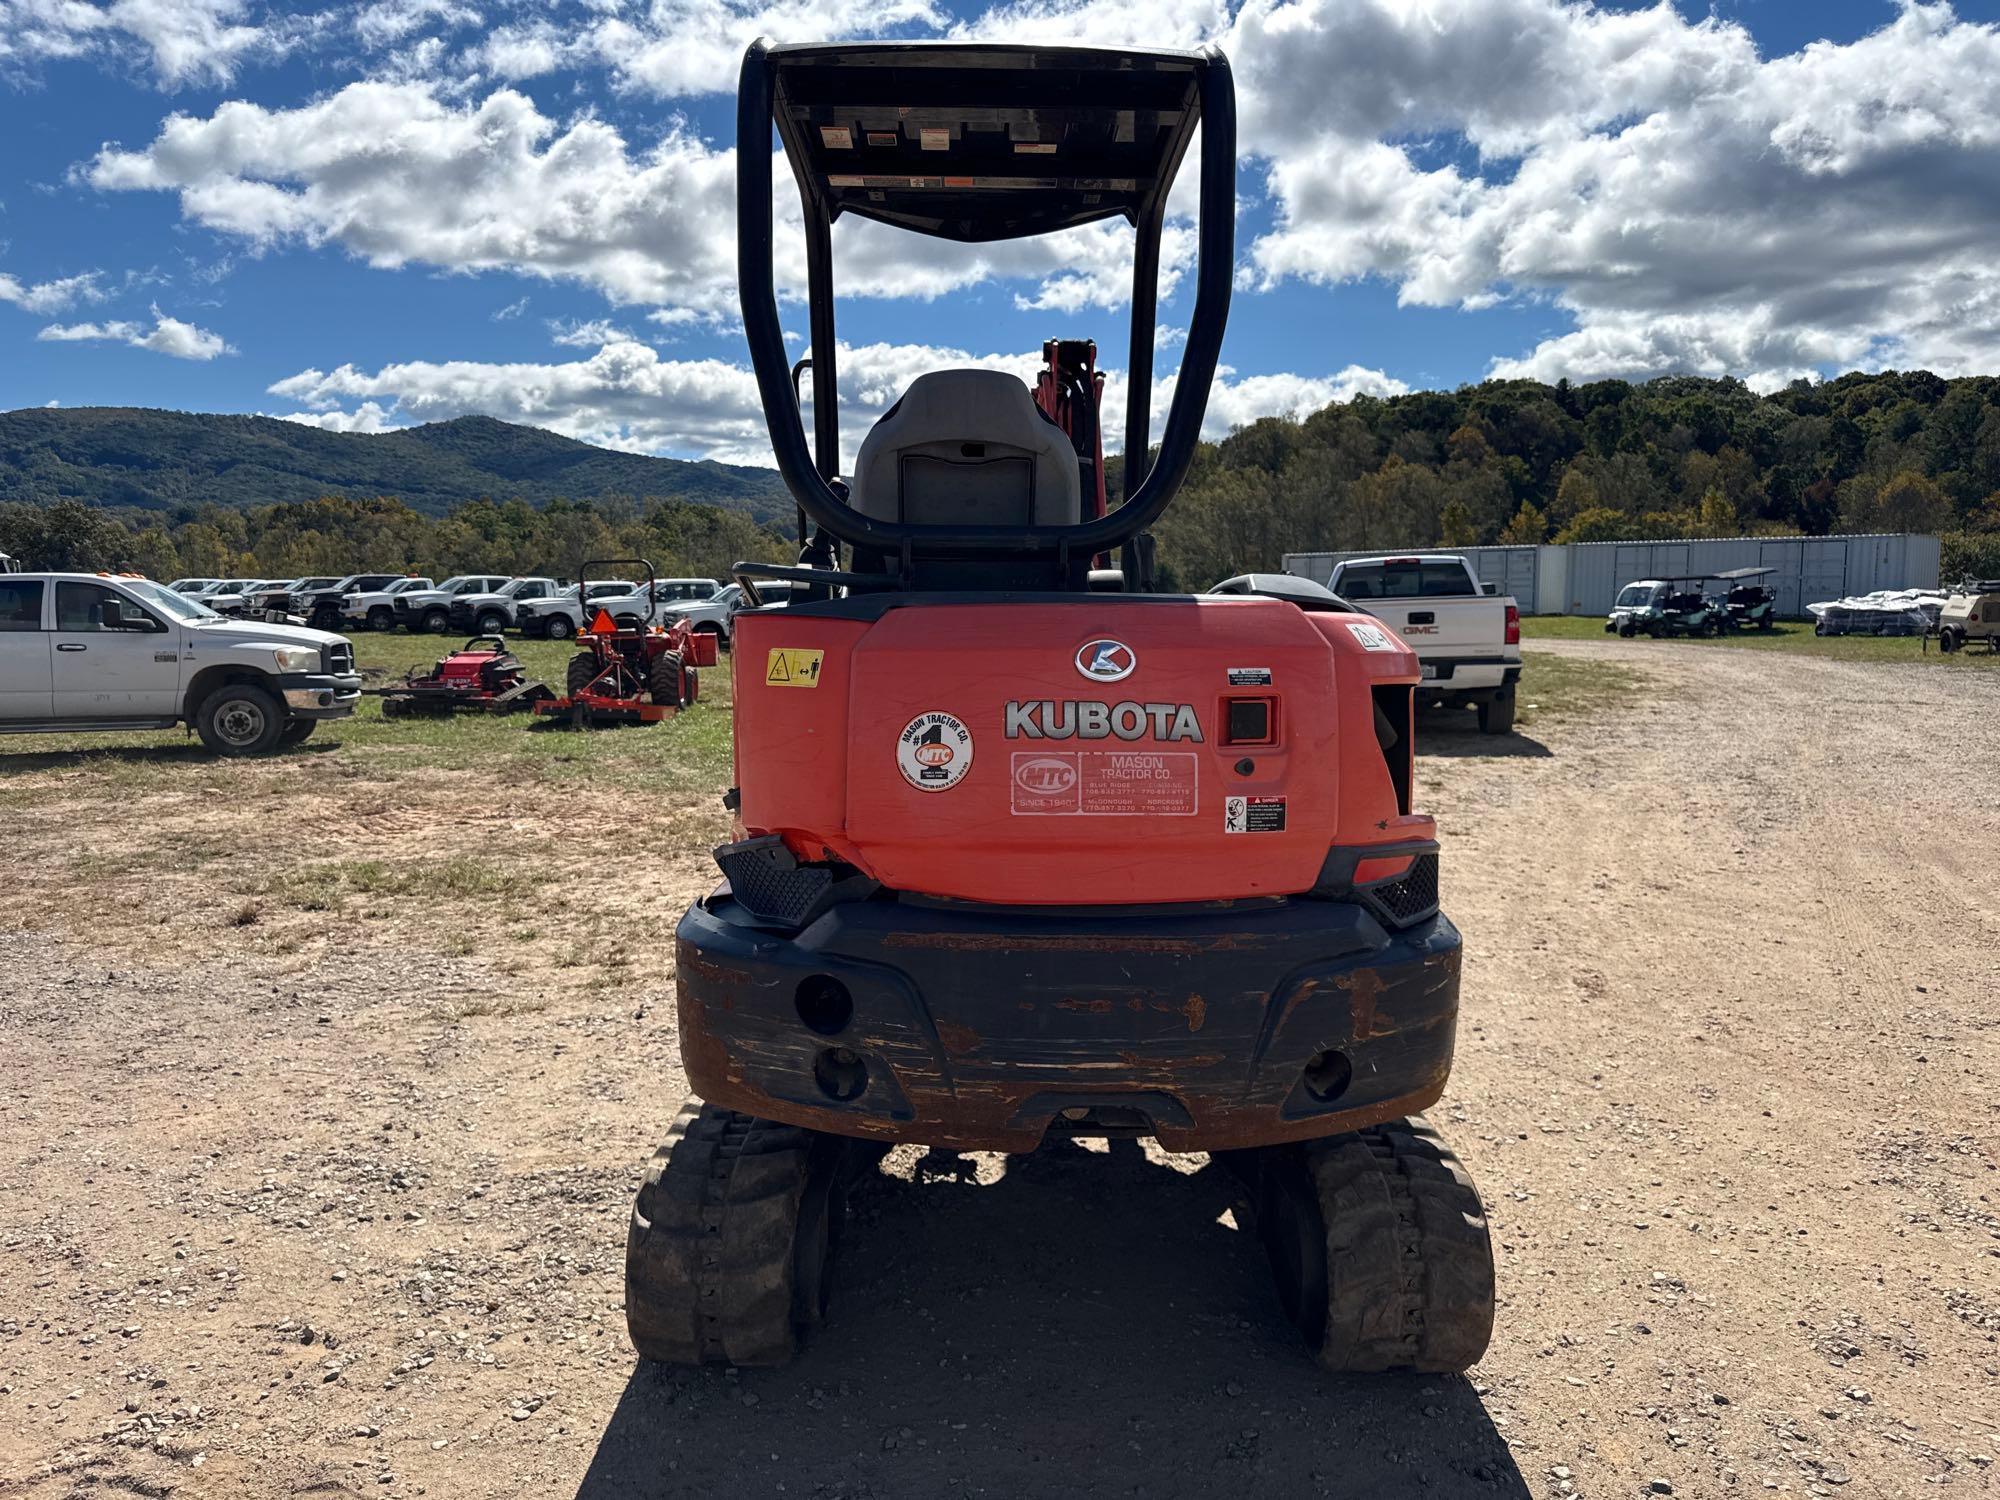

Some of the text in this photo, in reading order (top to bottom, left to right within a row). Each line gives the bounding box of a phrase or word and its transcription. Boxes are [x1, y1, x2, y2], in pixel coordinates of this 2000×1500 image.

[1403, 626, 1439, 635] GMC
[902, 714, 968, 745] MASON TRACTOR CO.
[1004, 701, 1205, 743] KUBOTA
[1111, 756, 1163, 769] MASON
[1019, 767, 1073, 786] MTC
[1101, 768, 1173, 780] TRACTOR CO.
